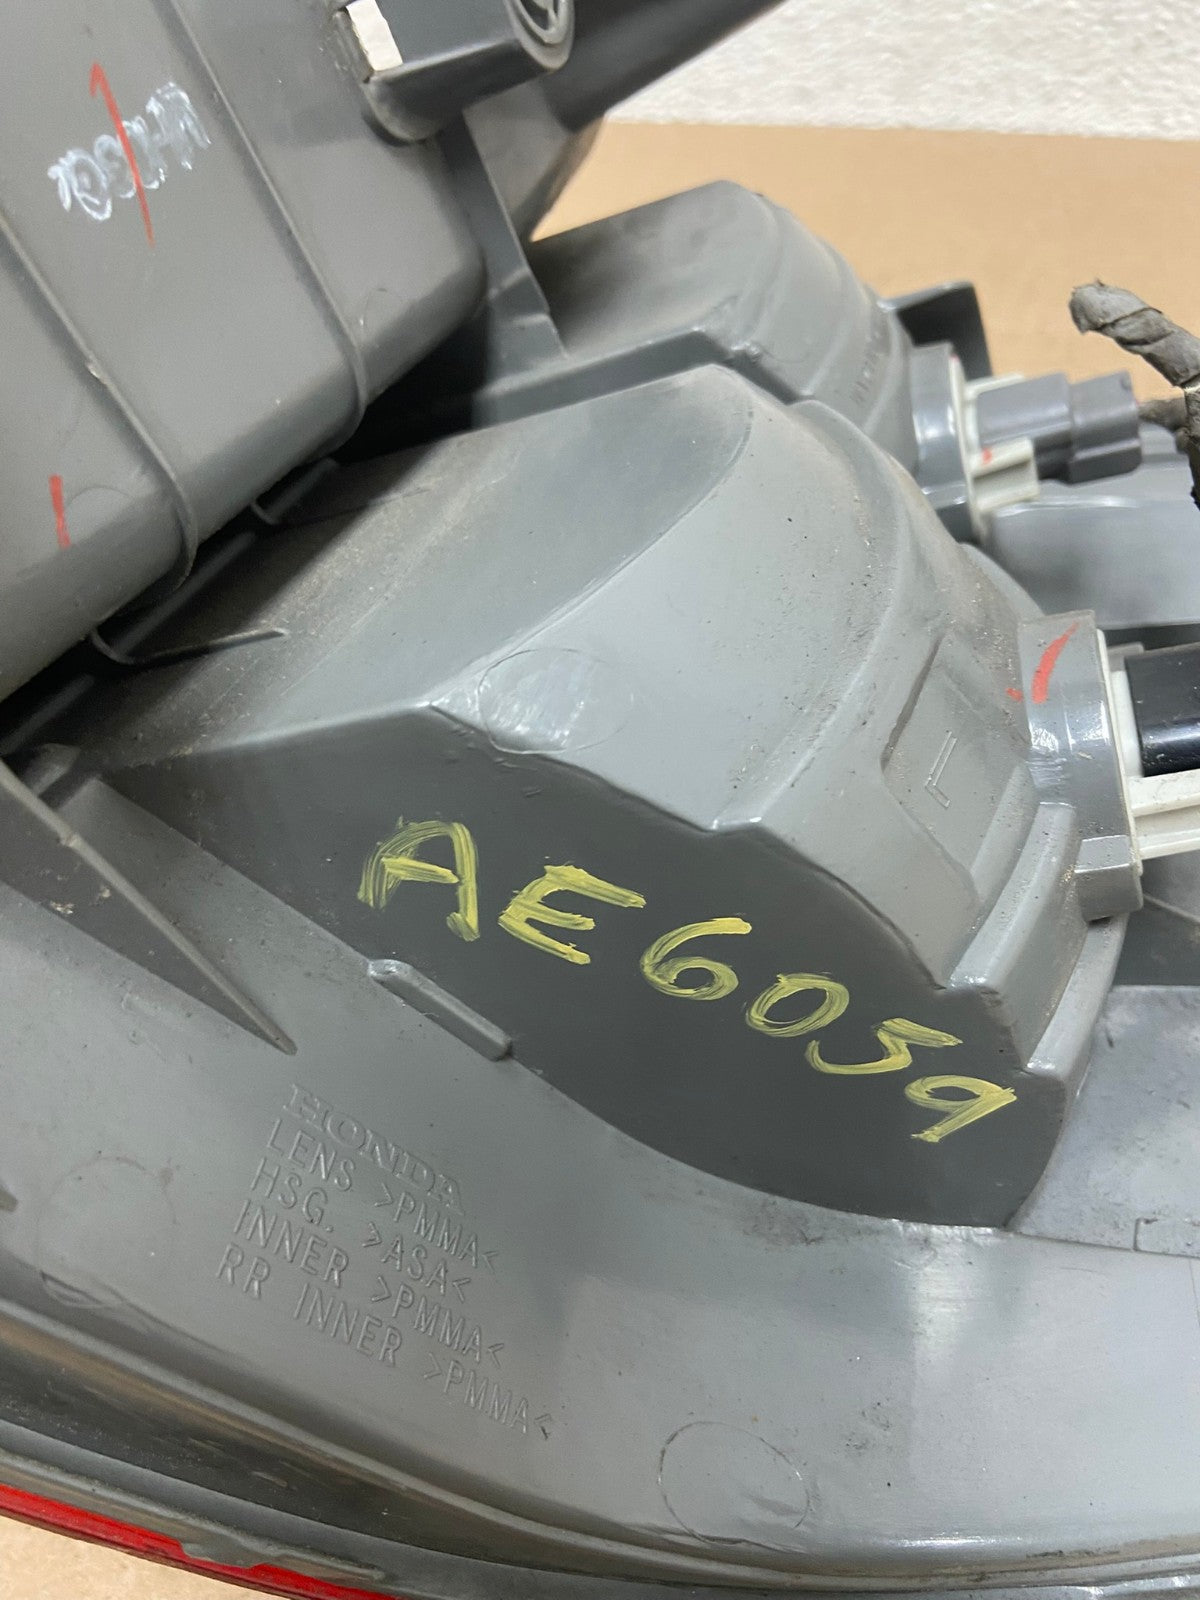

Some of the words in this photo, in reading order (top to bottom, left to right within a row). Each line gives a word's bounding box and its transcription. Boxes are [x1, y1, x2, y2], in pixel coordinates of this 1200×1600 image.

[250, 1156, 335, 1233] HSG.
[266, 1118, 356, 1193] LENS
[283, 1083, 465, 1217] HONDA
[233, 1199, 349, 1289] INNER
[216, 1243, 271, 1299] RR
[293, 1282, 403, 1368] INNER
